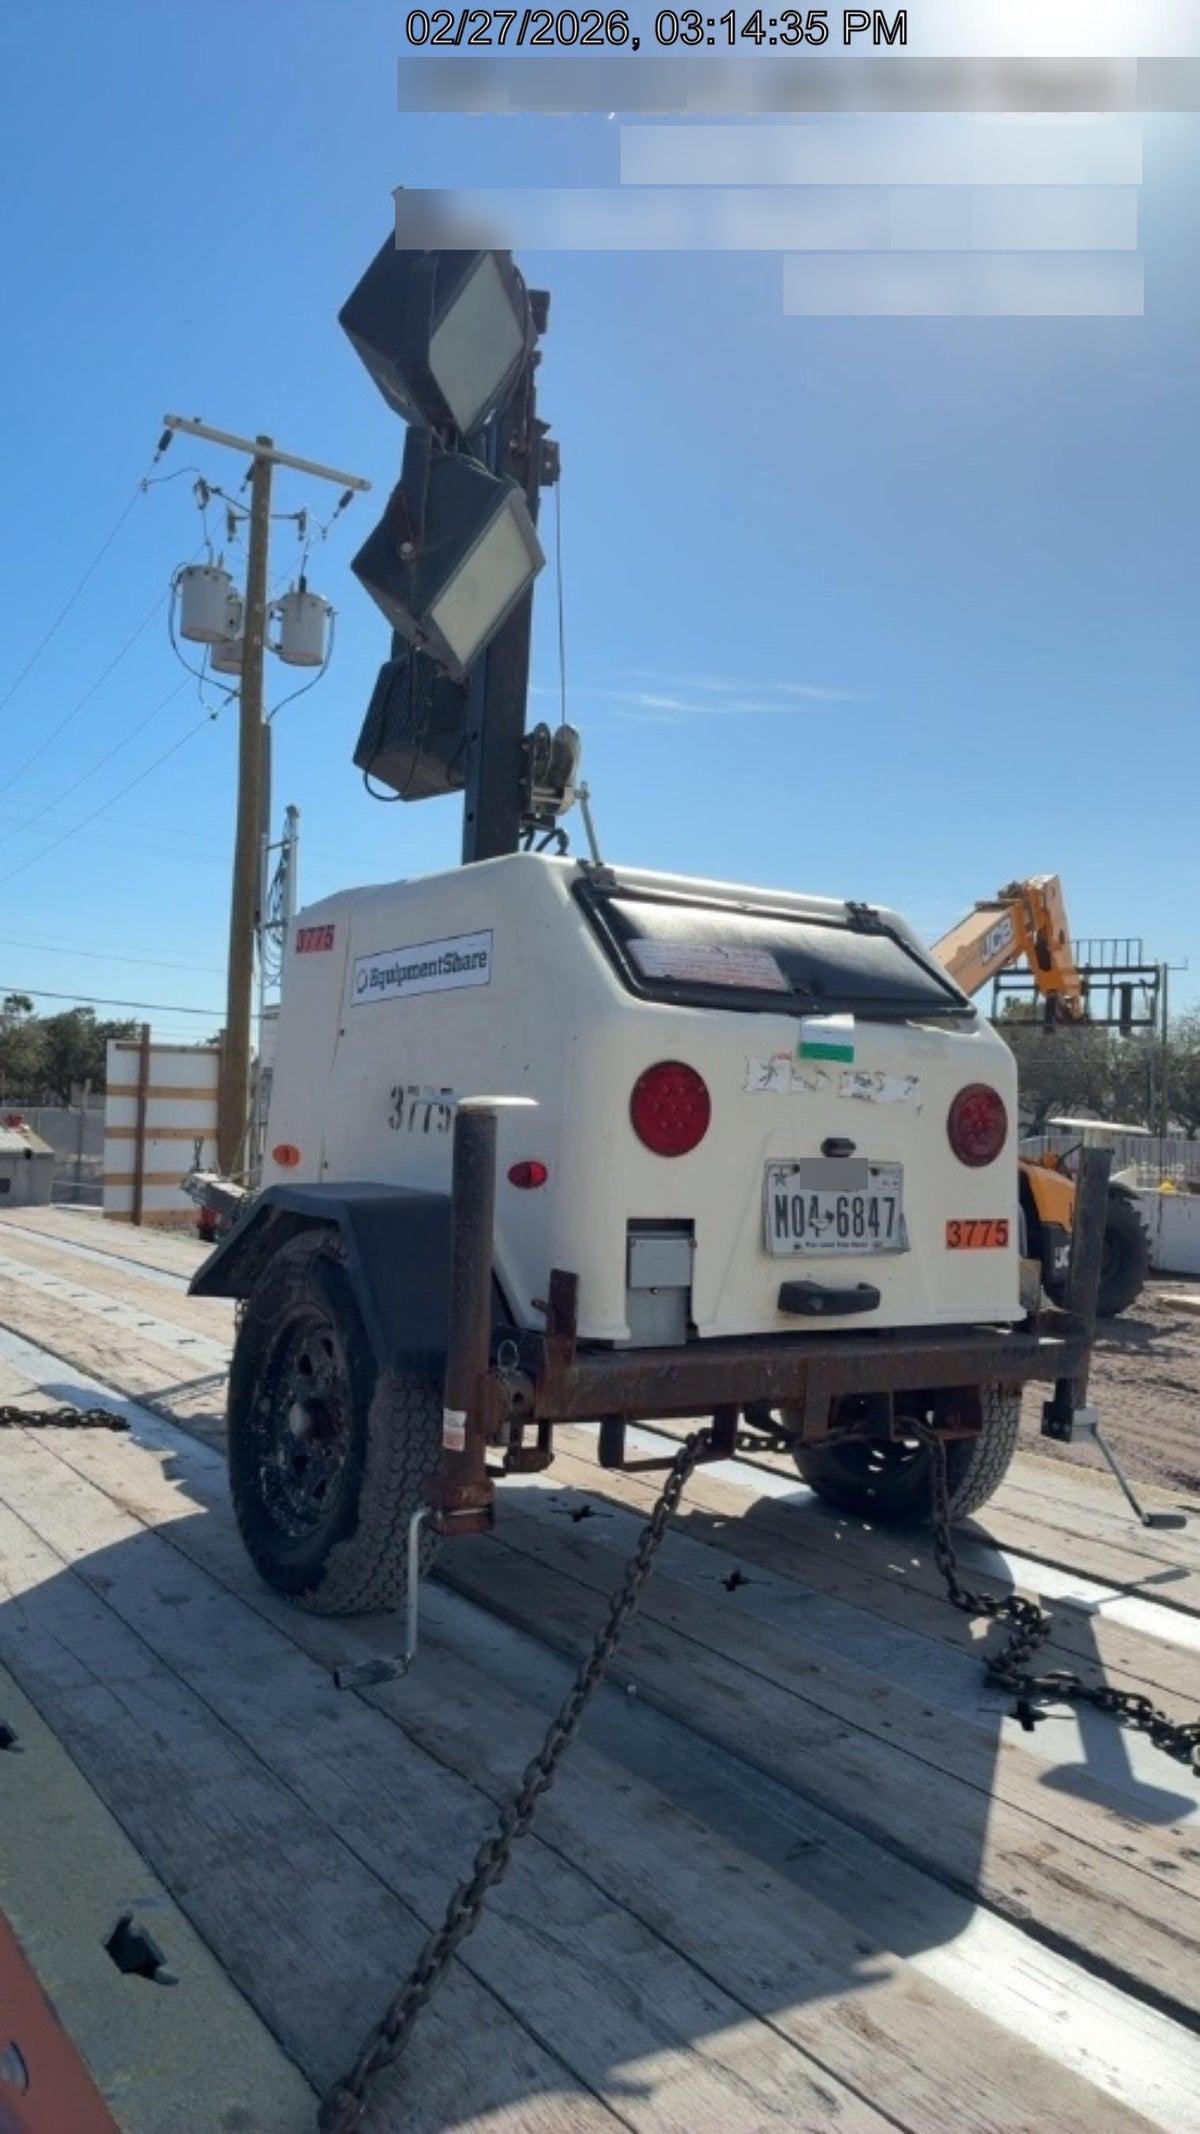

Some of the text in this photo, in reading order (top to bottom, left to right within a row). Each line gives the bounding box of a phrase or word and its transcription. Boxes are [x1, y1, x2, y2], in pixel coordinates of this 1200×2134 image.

[296, 925, 335, 953] 3775
[368, 950, 488, 990] EquipmentShare
[836, 1196, 895, 1239] 6847
[947, 1219, 1009, 1248] 3775
